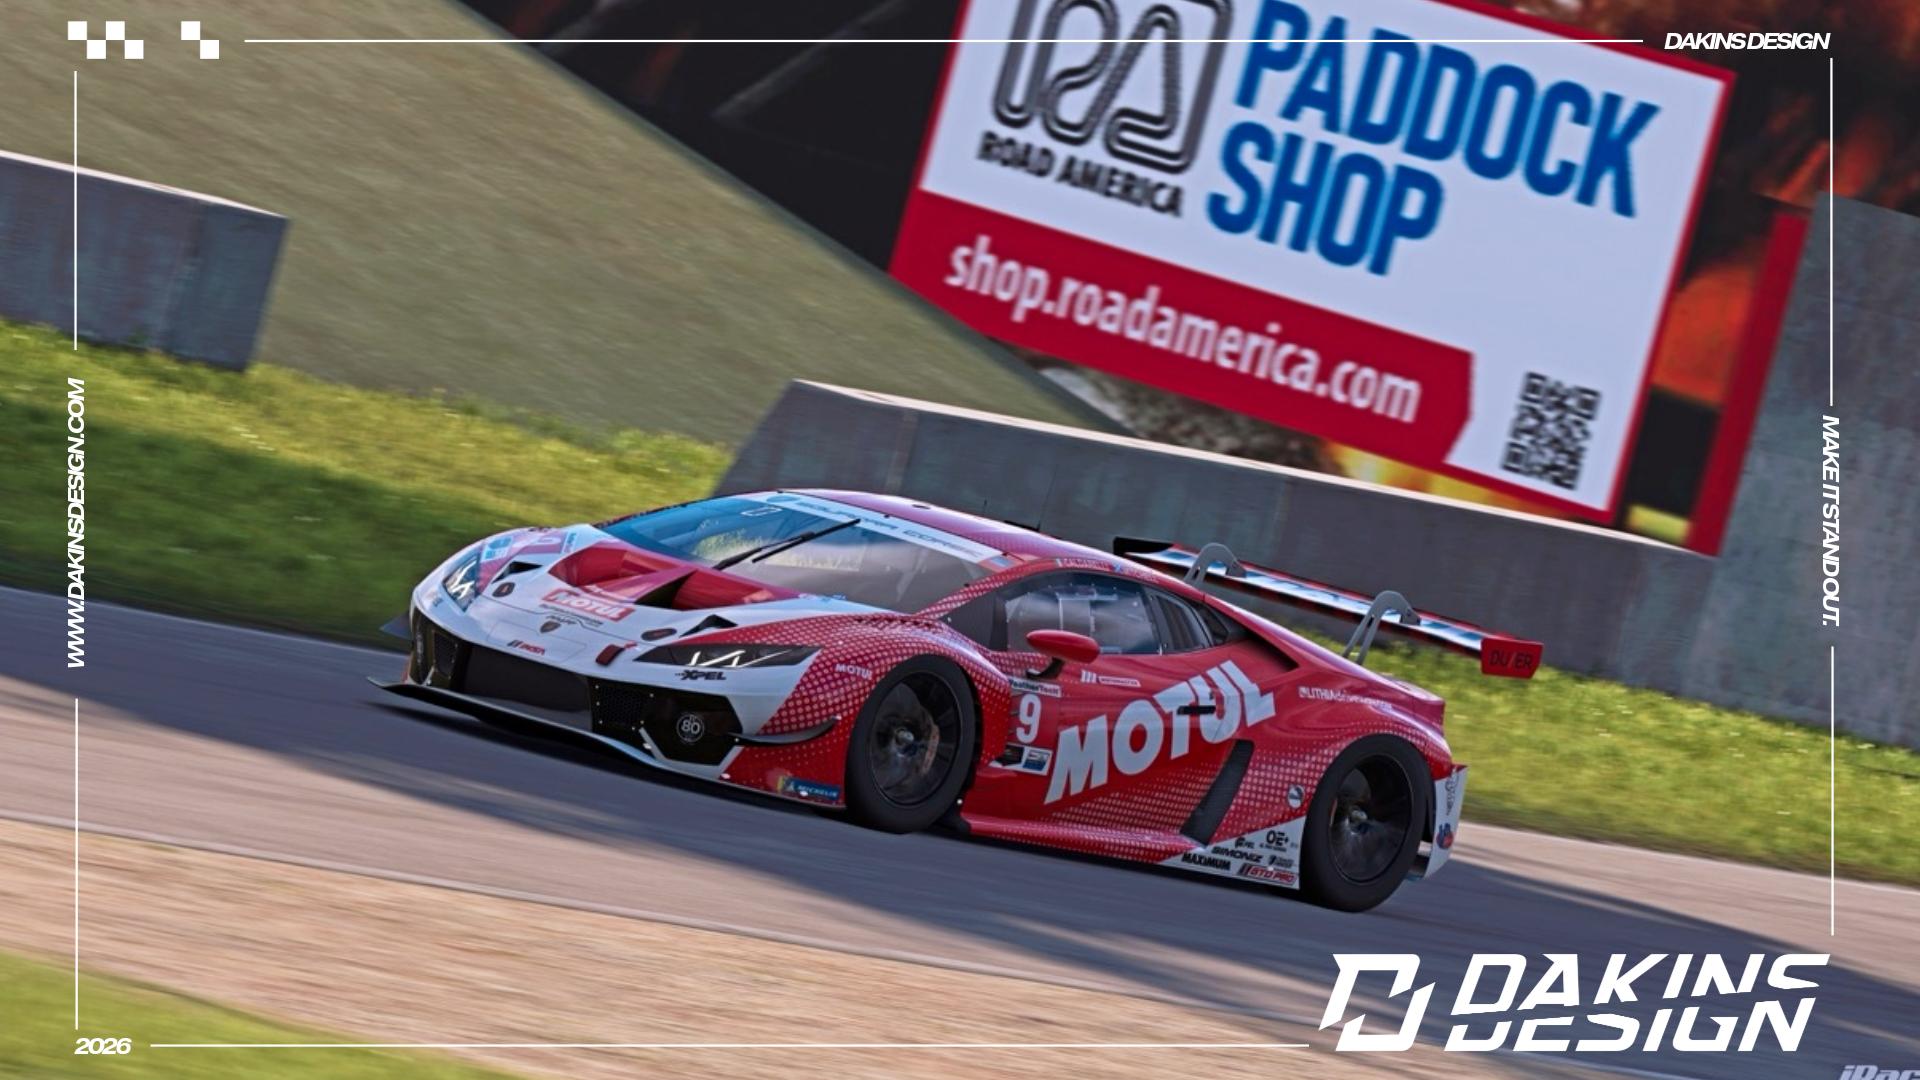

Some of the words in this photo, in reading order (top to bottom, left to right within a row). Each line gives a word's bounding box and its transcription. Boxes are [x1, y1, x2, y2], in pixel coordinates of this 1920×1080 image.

[1235, 0, 1661, 218] PADDOCK
[977, 130, 1055, 177] ROAD
[1055, 155, 1182, 217] AMERICA
[1207, 121, 1443, 276] SHOP
[944, 235, 1422, 424] shop.roadamerica.com
[679, 669, 727, 681] XPEL
[1016, 693, 1042, 743] 9
[681, 719, 701, 735] 80
[1044, 660, 1276, 804] MOTUL
[1182, 852, 1231, 871] MAXIMUM
